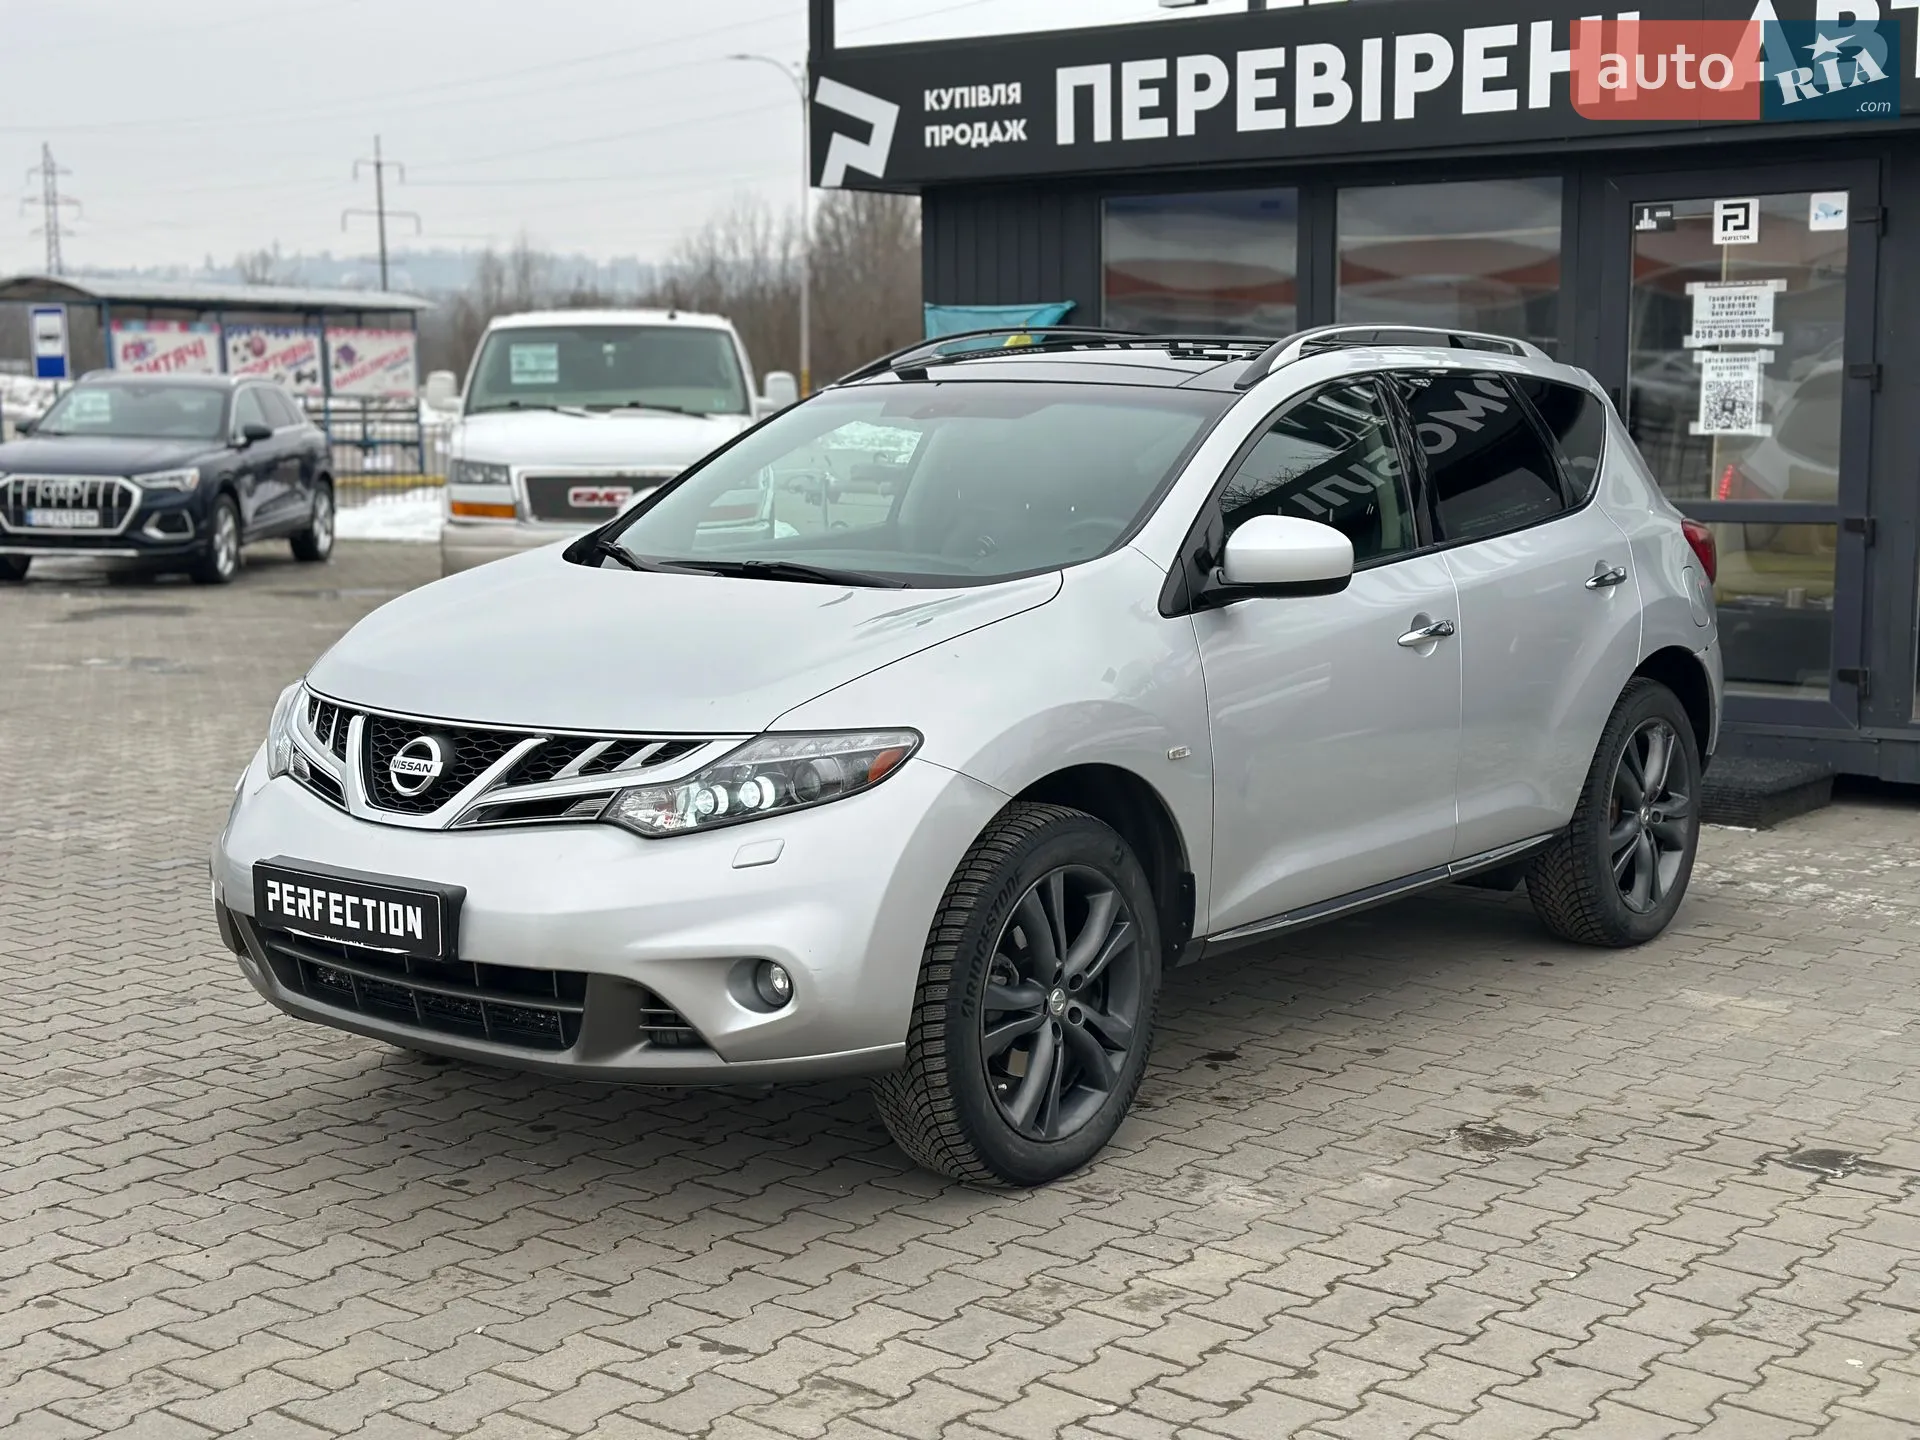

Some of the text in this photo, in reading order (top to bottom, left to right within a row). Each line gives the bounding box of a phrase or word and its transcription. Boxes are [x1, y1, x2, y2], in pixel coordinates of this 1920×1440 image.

[924, 82, 1021, 112] КУПІВЛЯ
[924, 118, 1027, 148] ПРОДАЖ
[1721, 234, 1750, 242] PERFECTION
[391, 759, 433, 773] NISSAN
[266, 879, 423, 941] PERFECTION
